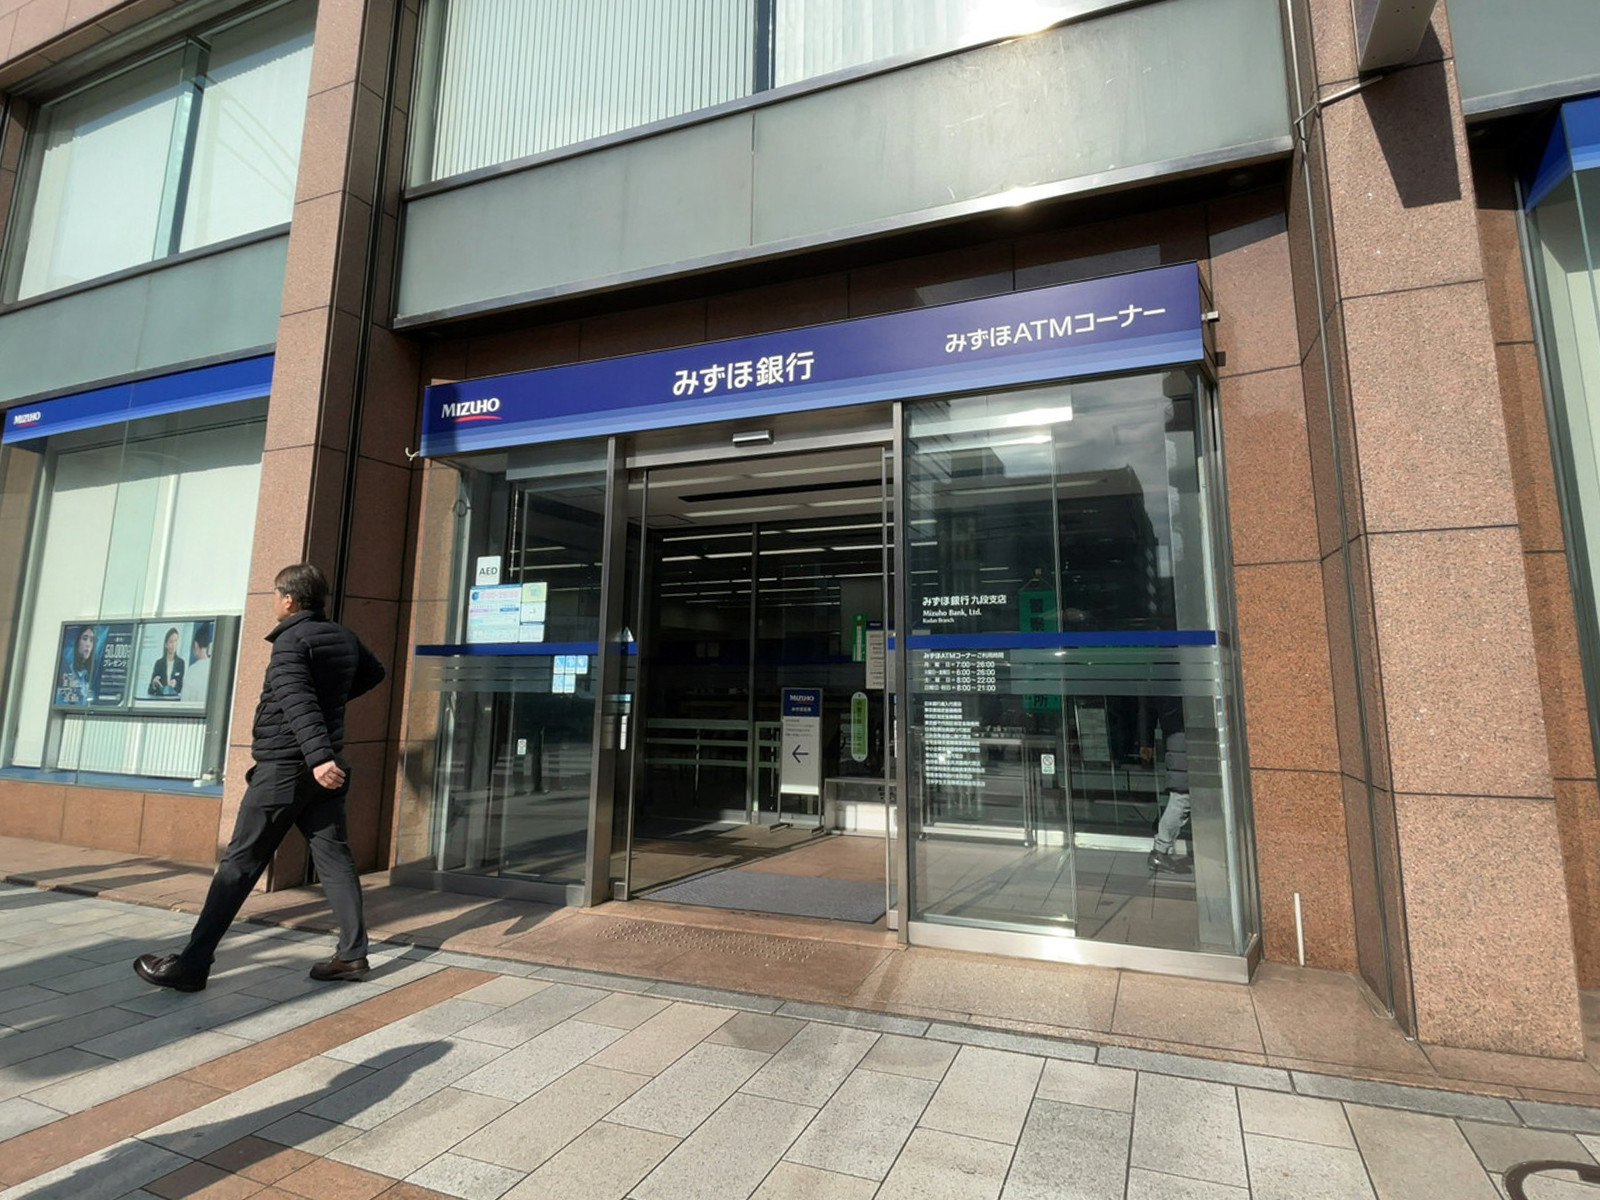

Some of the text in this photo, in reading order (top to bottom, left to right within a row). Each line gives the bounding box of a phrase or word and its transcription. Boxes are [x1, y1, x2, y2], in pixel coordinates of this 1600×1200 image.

[945, 304, 1166, 353] みずほATMコーナー
[672, 351, 815, 396] みずほ銀行
[440, 397, 501, 419] MIZUHO
[13, 411, 41, 425] MIZUHO
[479, 566, 498, 576] AED
[922, 608, 982, 617] Mizuho Bank, Ltd.
